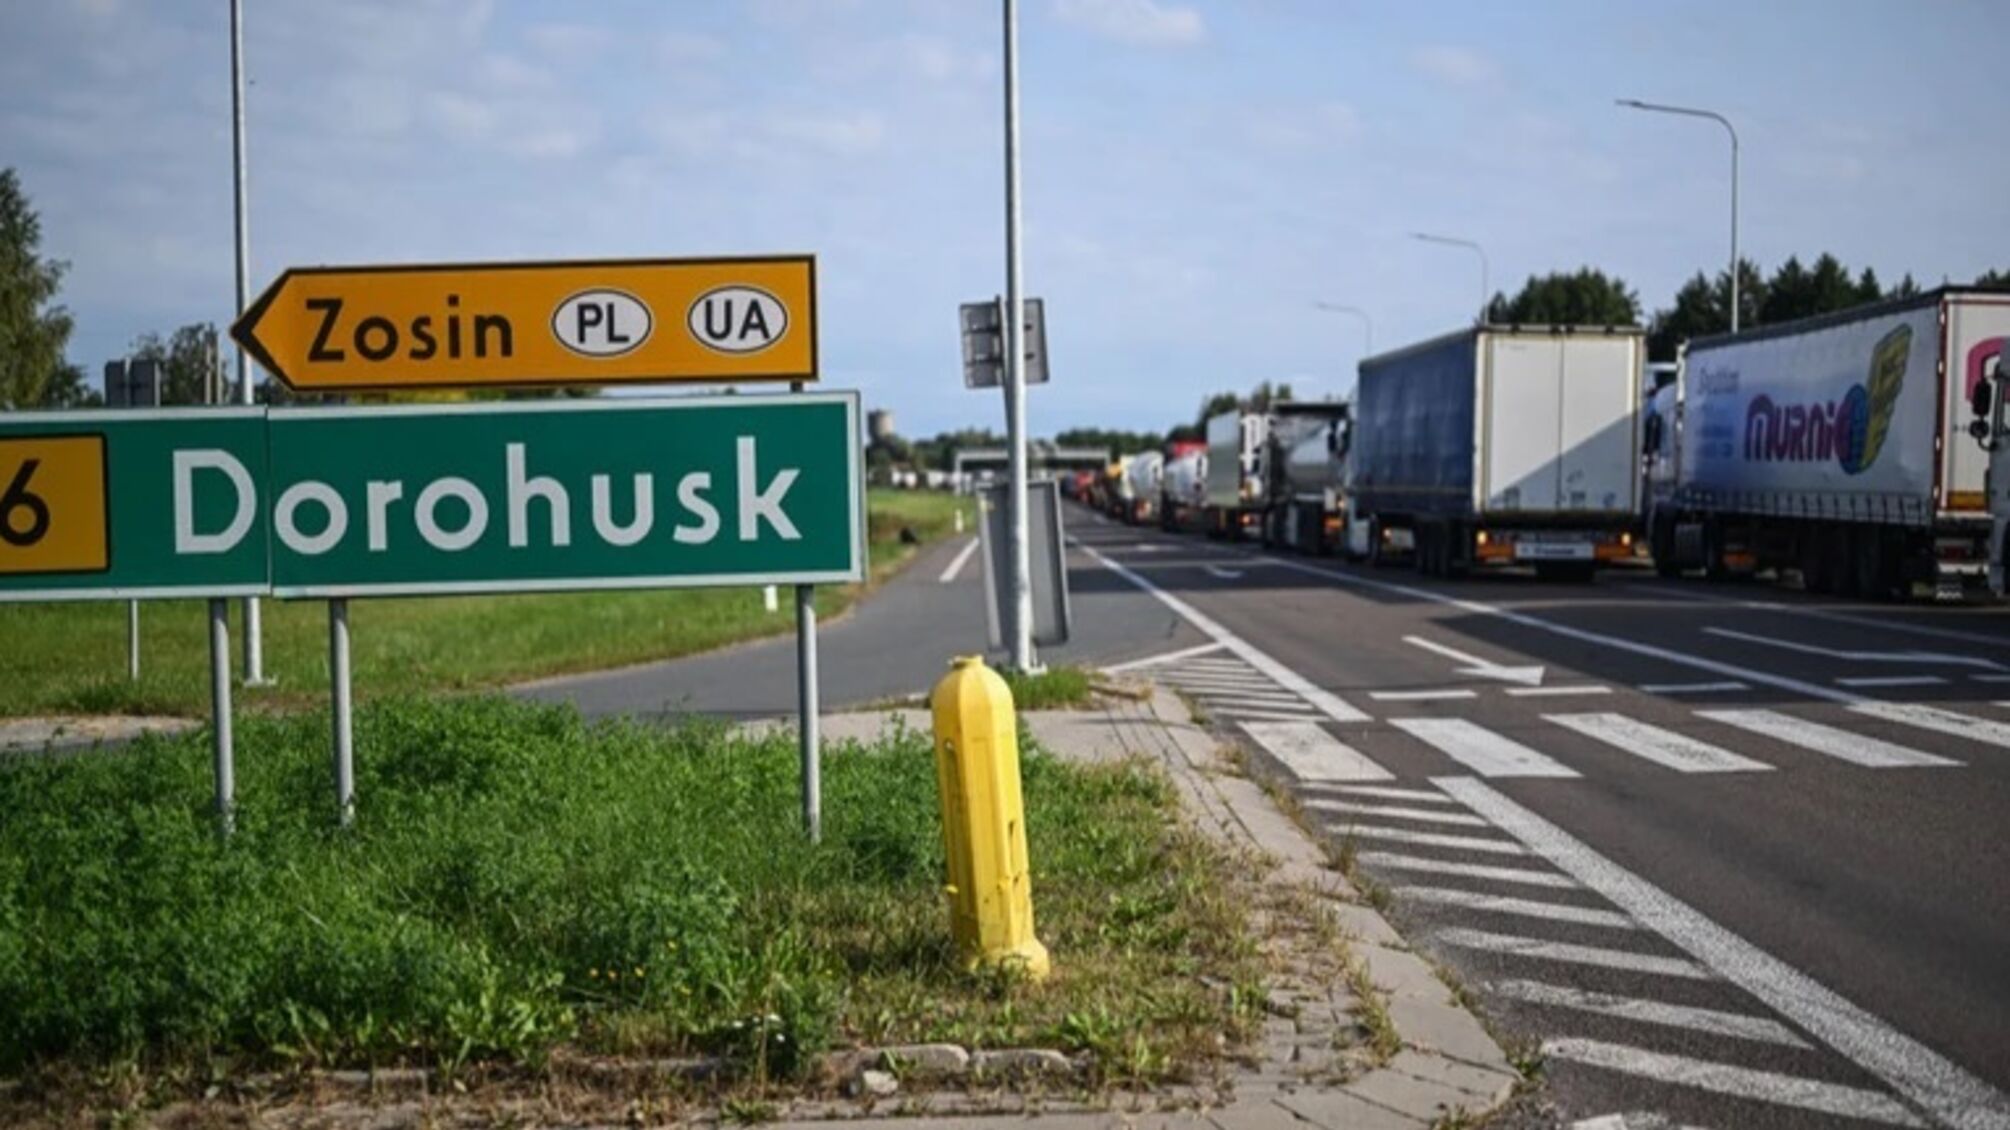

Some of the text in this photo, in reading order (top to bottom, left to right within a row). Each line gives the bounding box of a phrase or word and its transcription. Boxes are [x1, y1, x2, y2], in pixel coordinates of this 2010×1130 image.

[305, 294, 771, 363] Zosin PL UA
[0, 458, 50, 547] 6
[173, 436, 802, 555] Dorohusk
